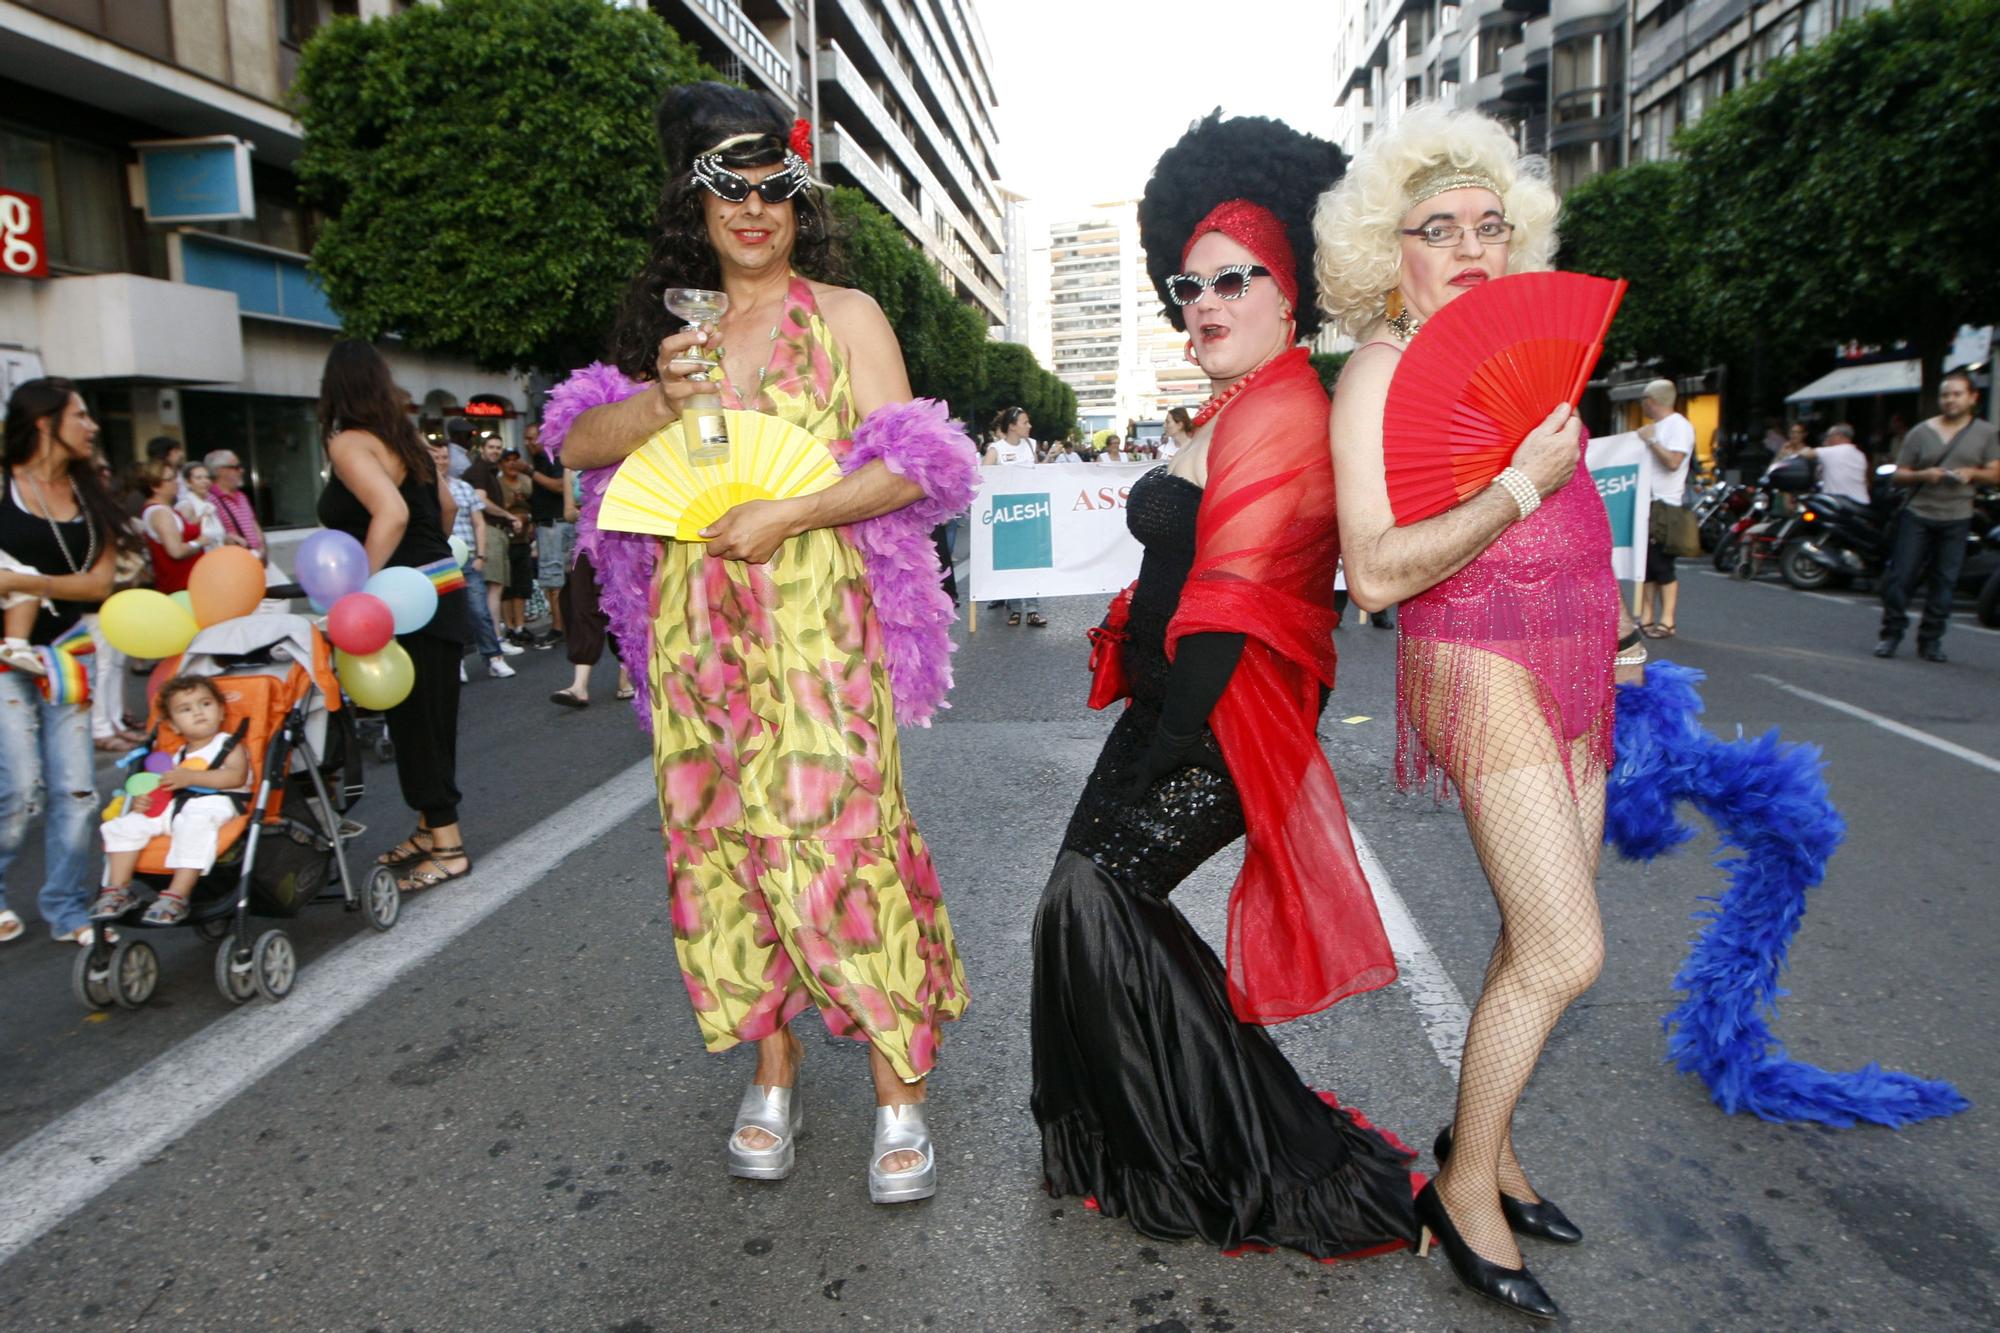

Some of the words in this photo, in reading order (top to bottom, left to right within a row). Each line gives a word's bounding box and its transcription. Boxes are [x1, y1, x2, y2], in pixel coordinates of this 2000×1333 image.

[1595, 473, 1637, 497] ESH
[1072, 486, 1132, 511] ASS
[982, 501, 1050, 525] GALESH
